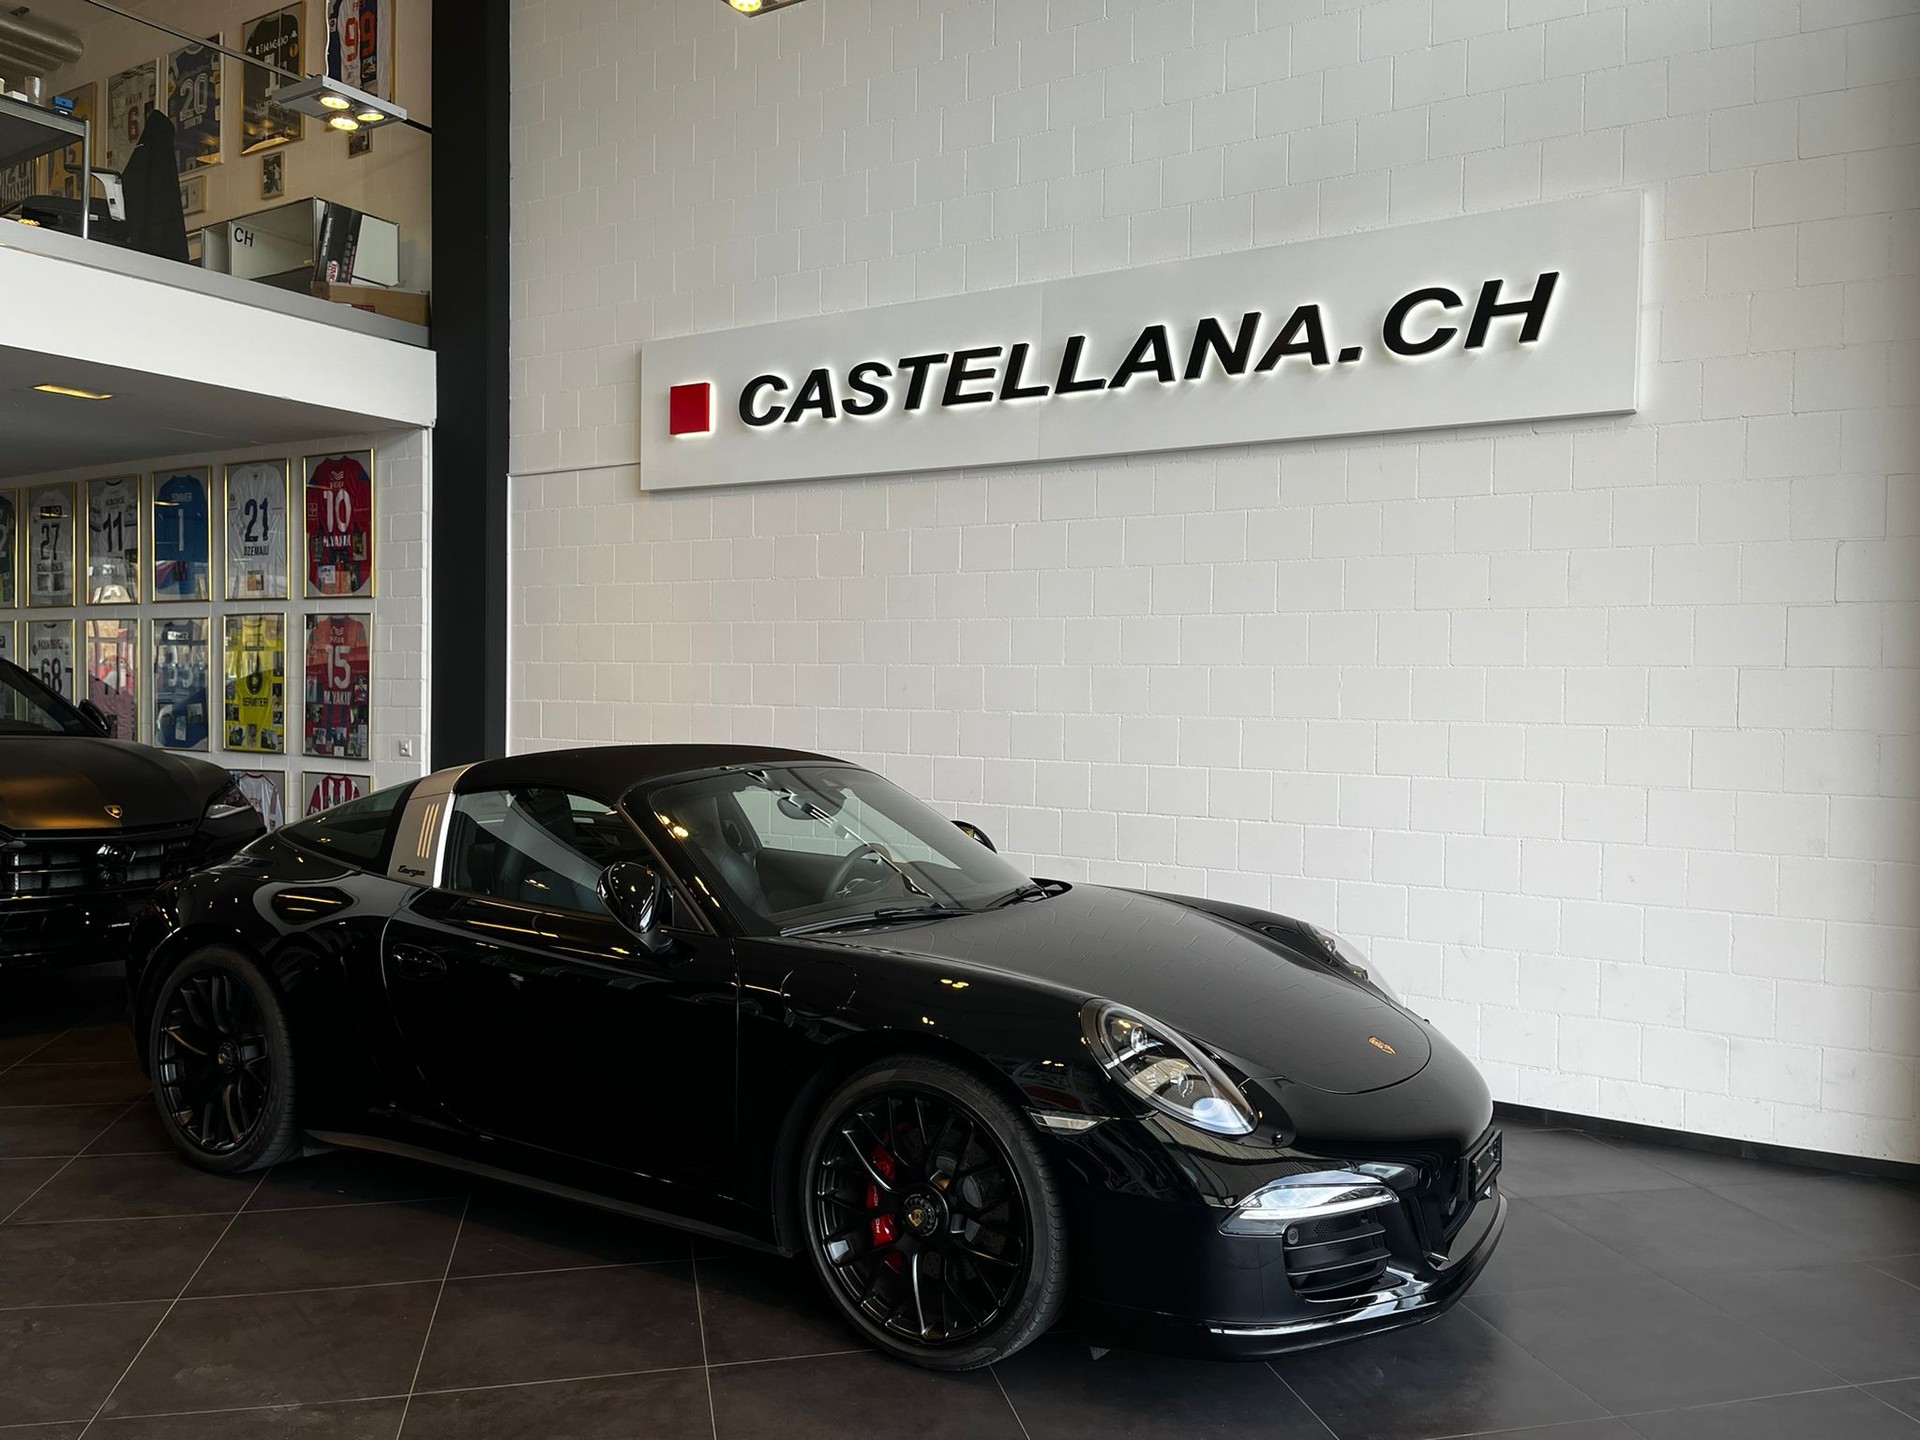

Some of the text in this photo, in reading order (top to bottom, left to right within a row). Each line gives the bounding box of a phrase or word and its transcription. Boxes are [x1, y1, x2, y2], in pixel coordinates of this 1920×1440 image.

[180, 72, 208, 122] 20
[234, 227, 254, 247] CH
[738, 271, 1560, 427] CASTELLANA.CH
[102, 511, 123, 552] 11
[178, 508, 185, 552] 1
[244, 497, 269, 542] 21
[323, 489, 352, 533] 10
[41, 522, 60, 560] 27
[41, 658, 62, 693] 68
[325, 645, 351, 689] 15
